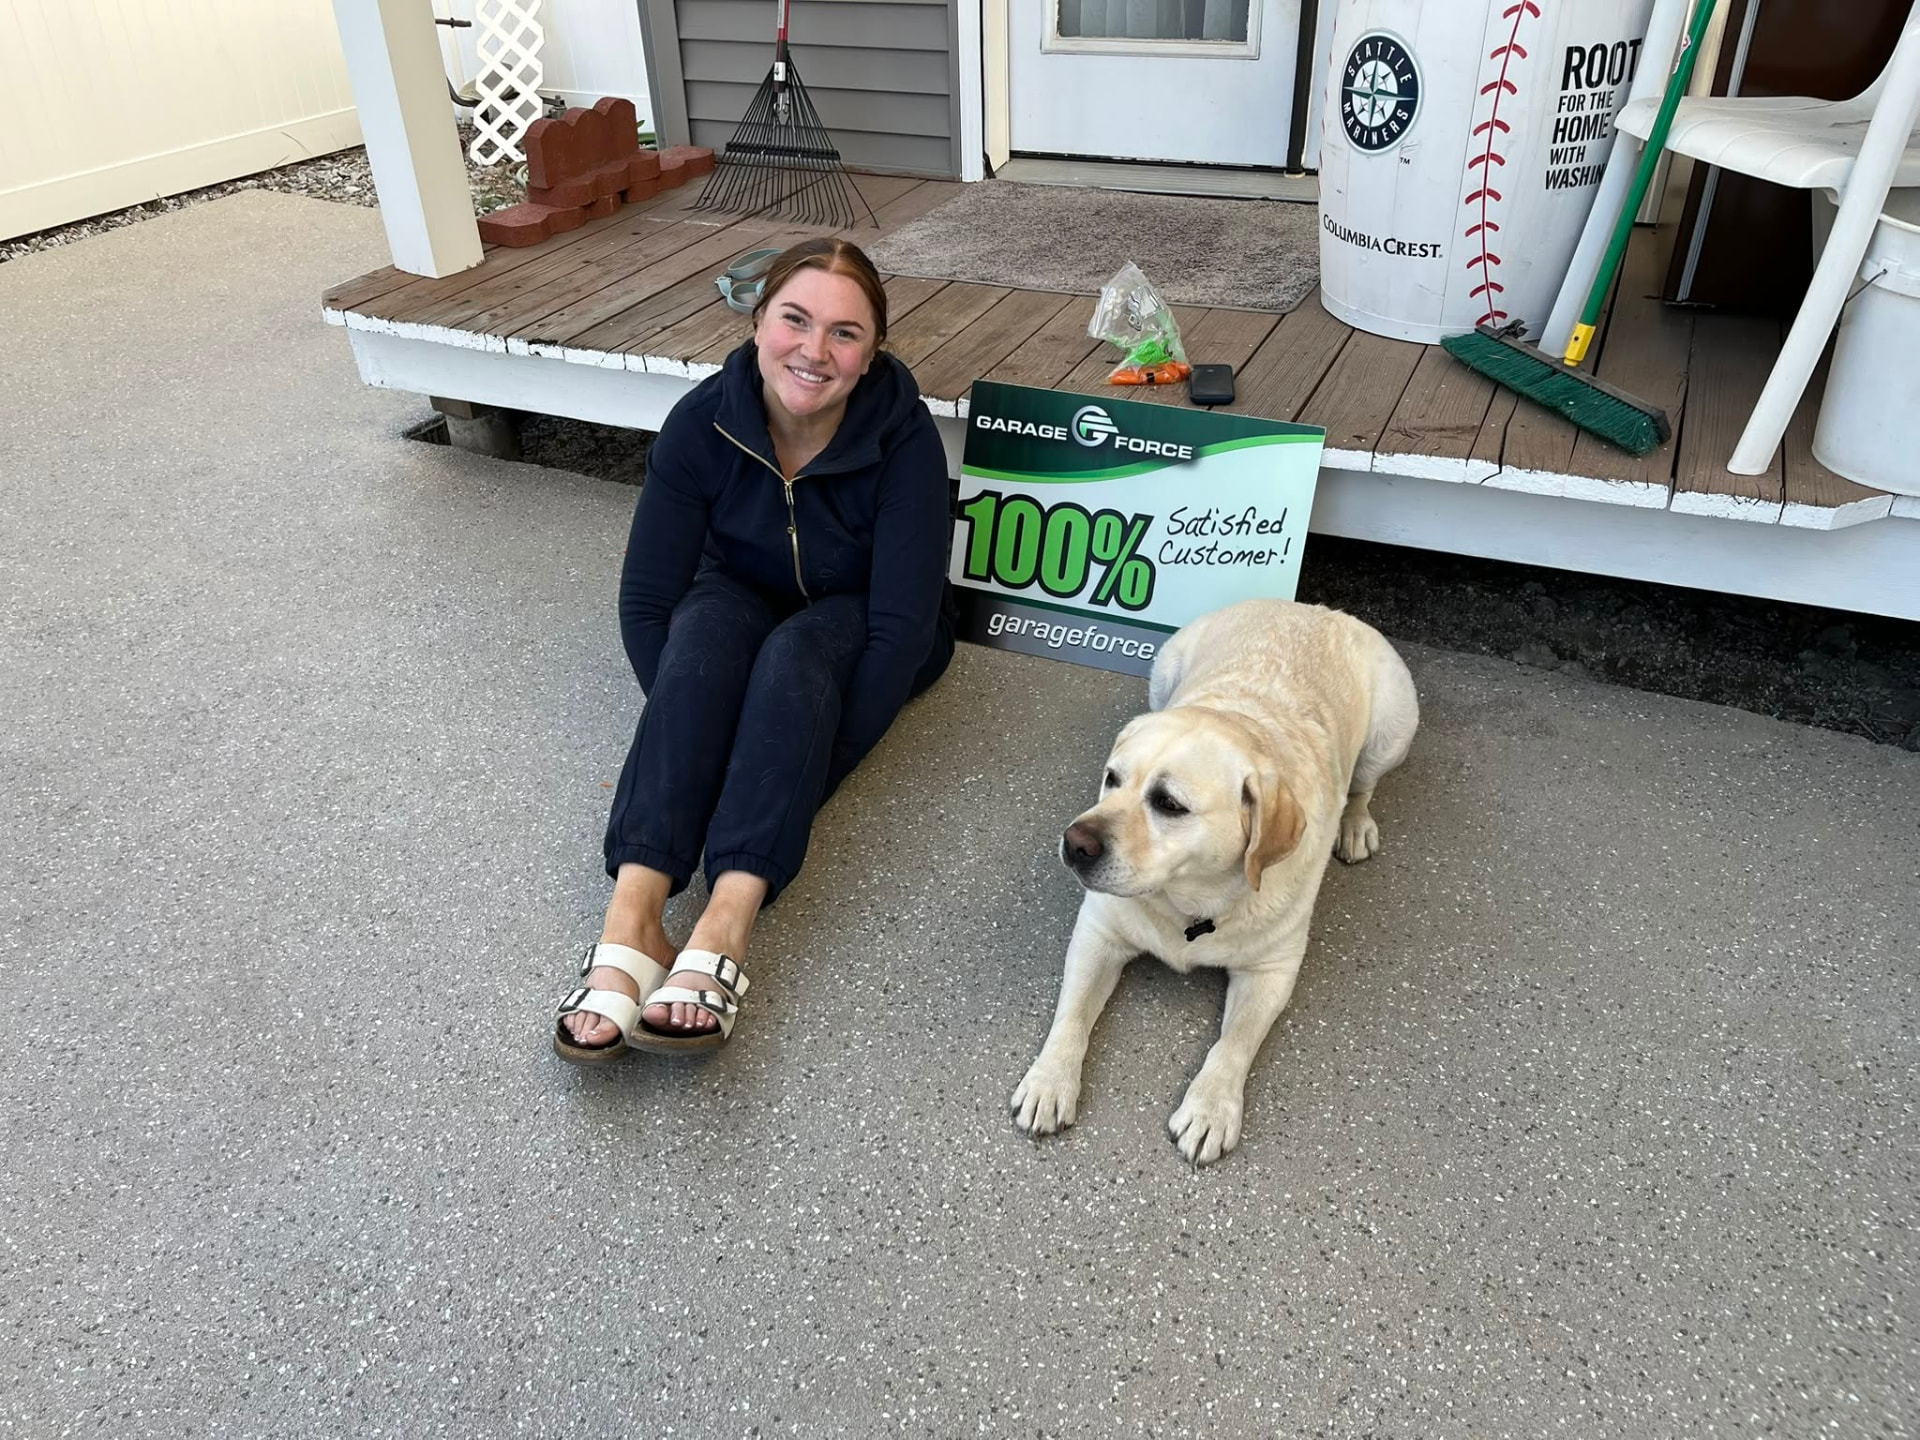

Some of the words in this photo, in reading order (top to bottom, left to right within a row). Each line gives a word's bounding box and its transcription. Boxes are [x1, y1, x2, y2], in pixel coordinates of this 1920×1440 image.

[1347, 41, 1412, 84] SEATTLE
[1561, 38, 1642, 91] ROOT
[1557, 94, 1586, 113] FOR
[1590, 90, 1615, 110] THE
[1343, 101, 1409, 145] MARINERS
[1552, 112, 1611, 144] HOME
[1550, 146, 1586, 165] WITH
[1545, 162, 1607, 190] WASHIN
[1323, 213, 1382, 252] COLUMBIA
[1383, 237, 1441, 259] CREST
[976, 415, 1068, 441] GARAGE
[1114, 435, 1194, 460] FORCE
[1166, 507, 1288, 537] Satisfied
[958, 489, 1156, 612] 100%
[1158, 537, 1292, 567] Customer!
